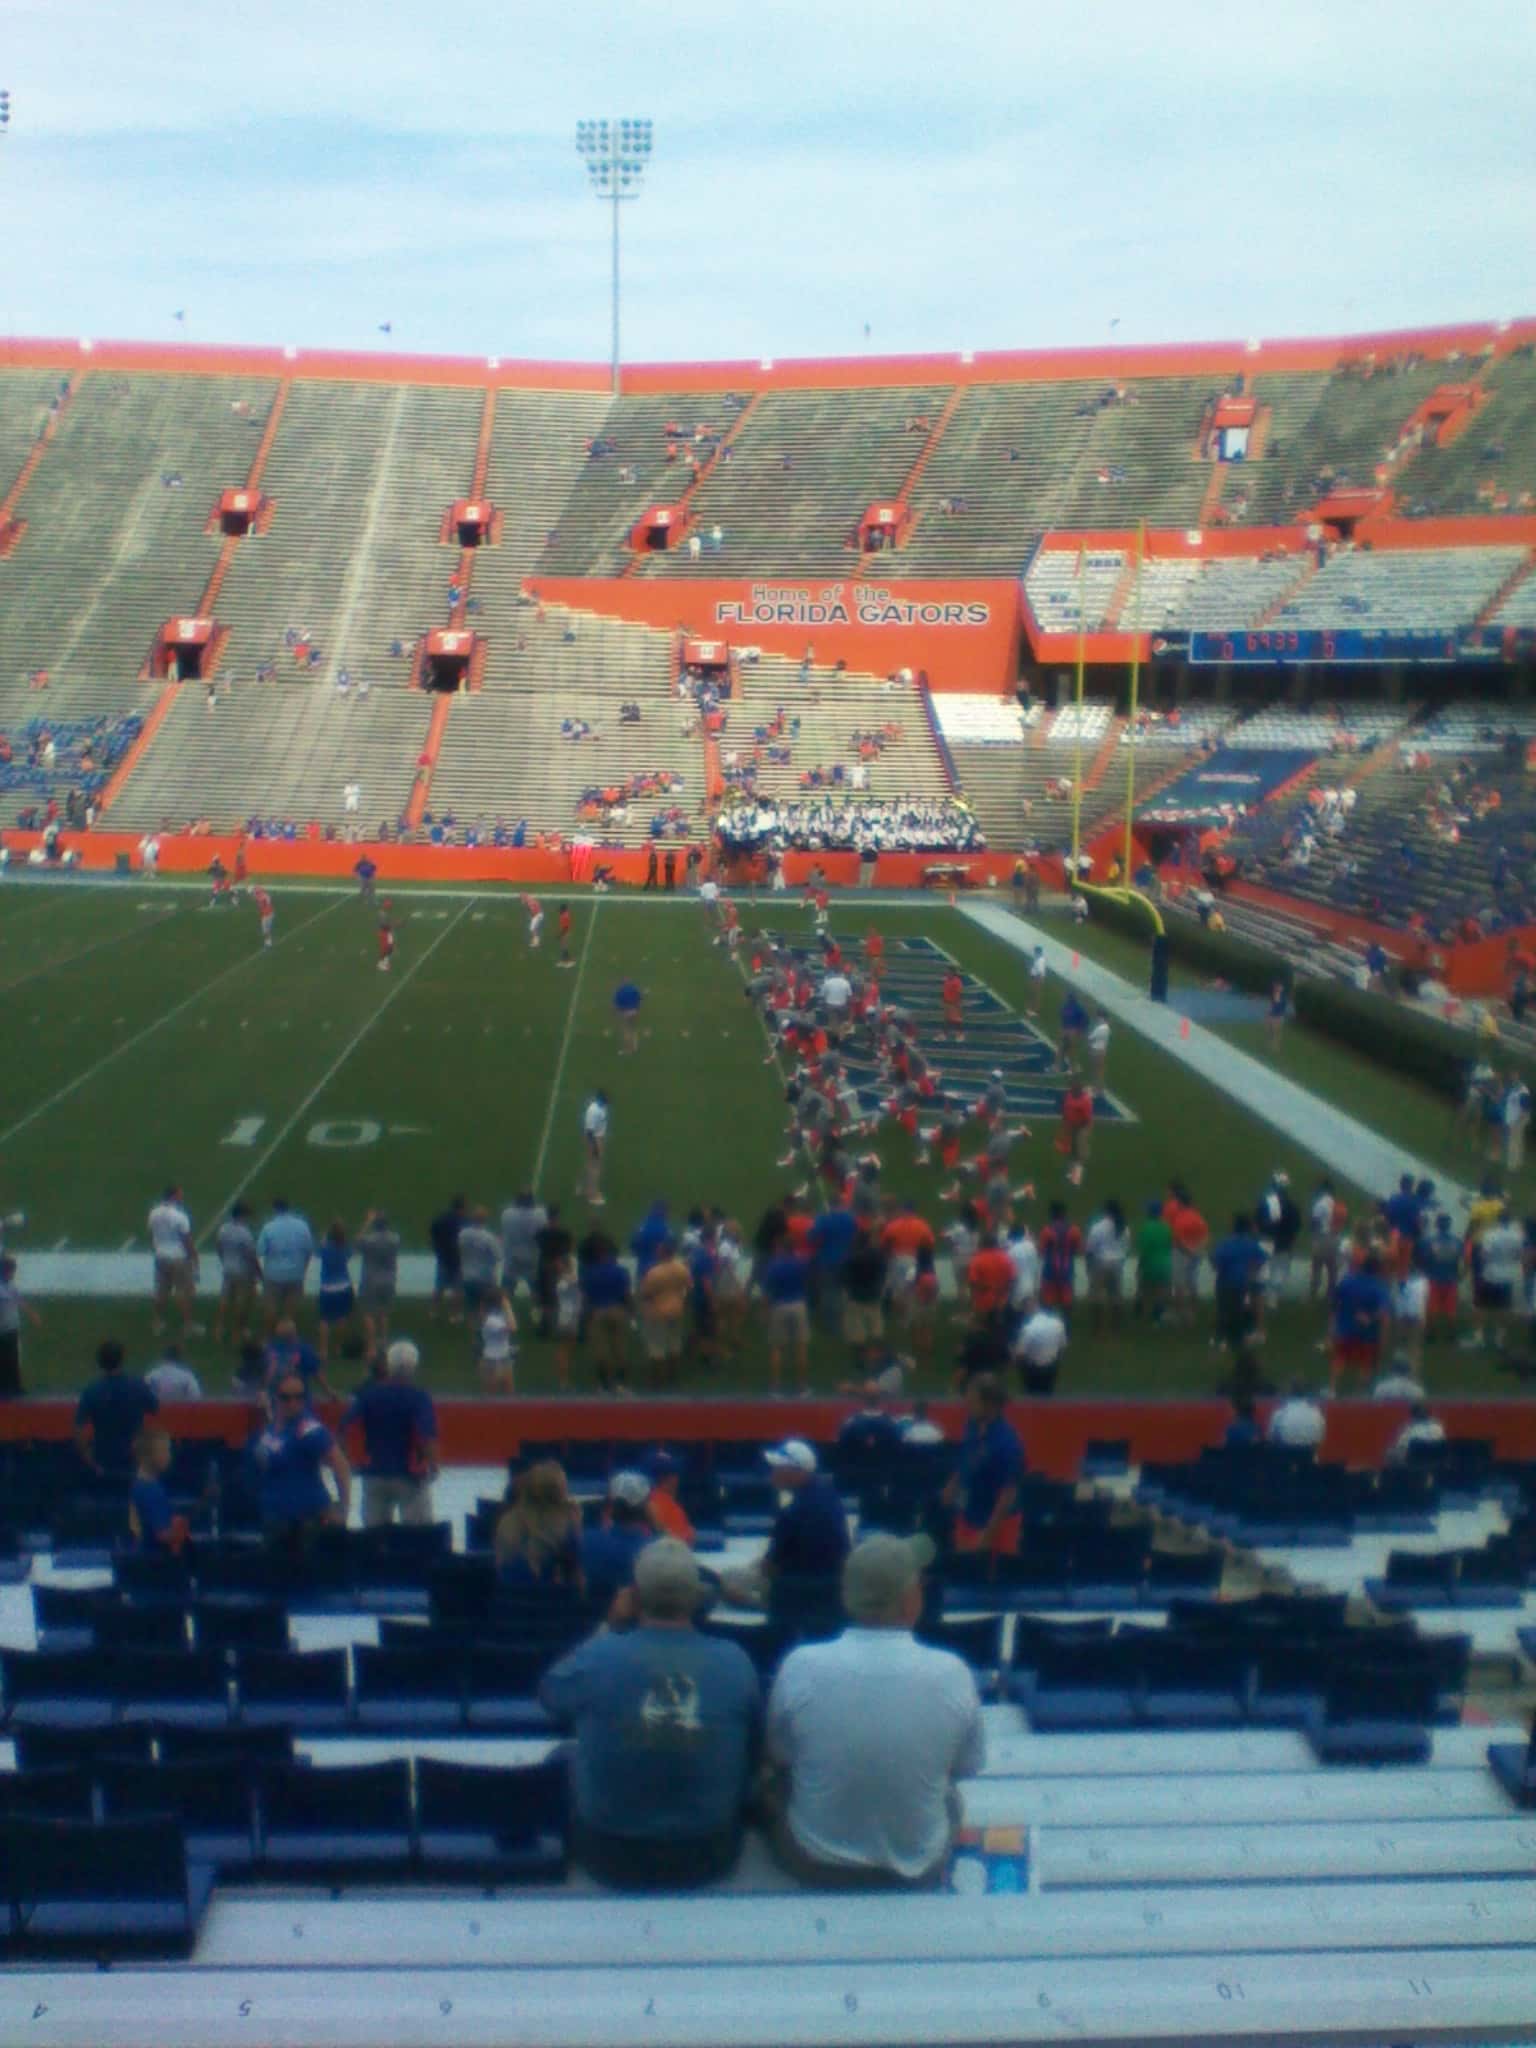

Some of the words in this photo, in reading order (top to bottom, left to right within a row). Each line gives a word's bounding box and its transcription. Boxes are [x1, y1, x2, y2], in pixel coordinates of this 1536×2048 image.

[752, 585, 809, 602] Home
[821, 585, 842, 602] of
[855, 584, 889, 602] the
[715, 601, 850, 624] FLORIDA
[858, 601, 990, 625] GATORS
[238, 1999, 253, 2017] 5
